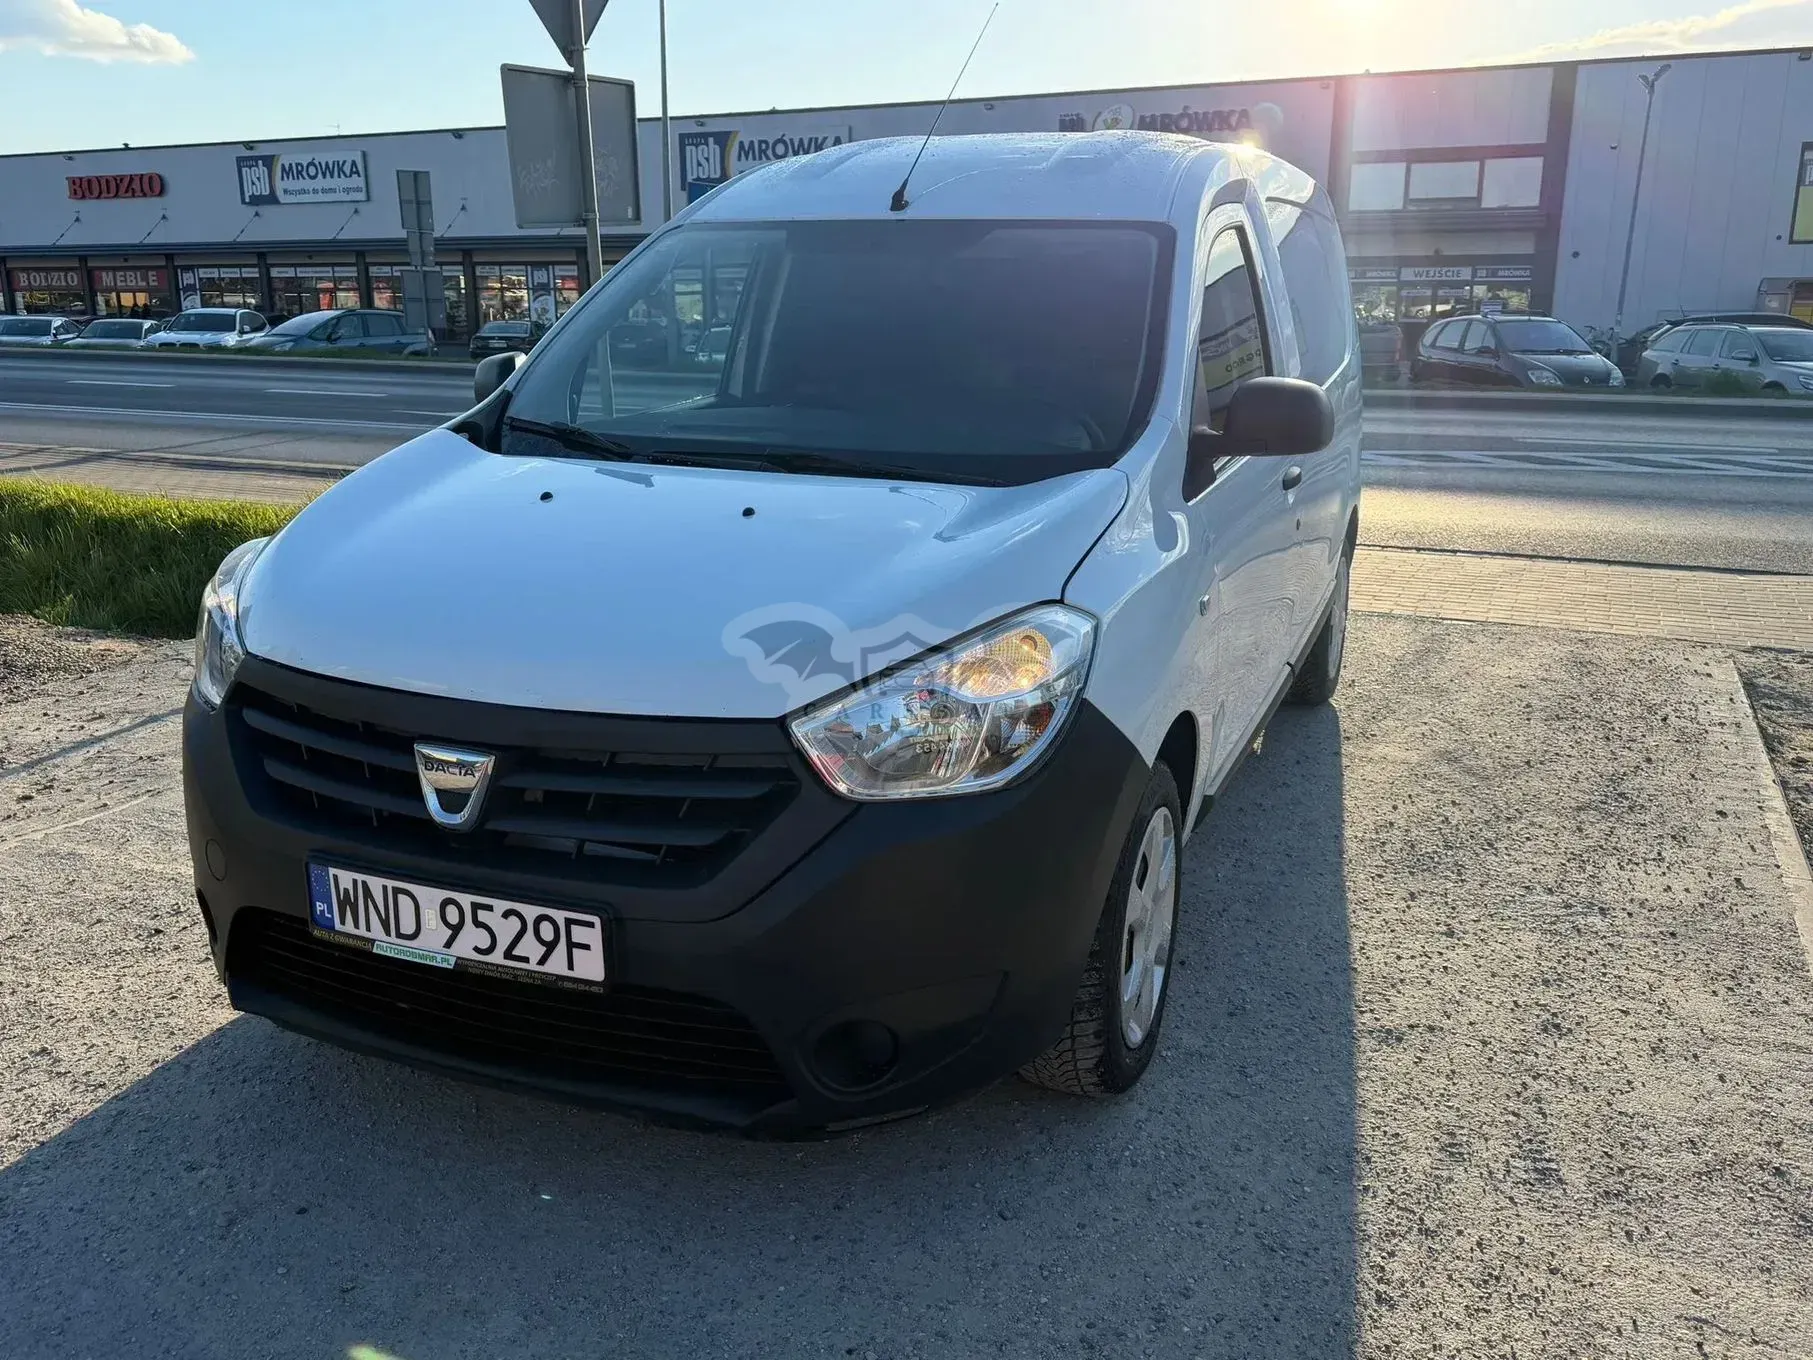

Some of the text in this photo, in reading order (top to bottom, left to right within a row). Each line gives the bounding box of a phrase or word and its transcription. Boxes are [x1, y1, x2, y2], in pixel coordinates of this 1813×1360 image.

[1138, 105, 1250, 133] MRÓWKA
[280, 157, 361, 181] MRÓWKA
[685, 137, 721, 183] psb
[66, 172, 163, 200] BODZIO
[241, 160, 270, 202] psb
[311, 187, 320, 195] do
[18, 271, 78, 287] BODZIO
[101, 270, 159, 287] MEBLE
[1413, 266, 1462, 278] WEJŚCIE
[424, 760, 476, 778] DACIA
[315, 900, 332, 919] PL
[333, 873, 595, 971] WND 9529F
